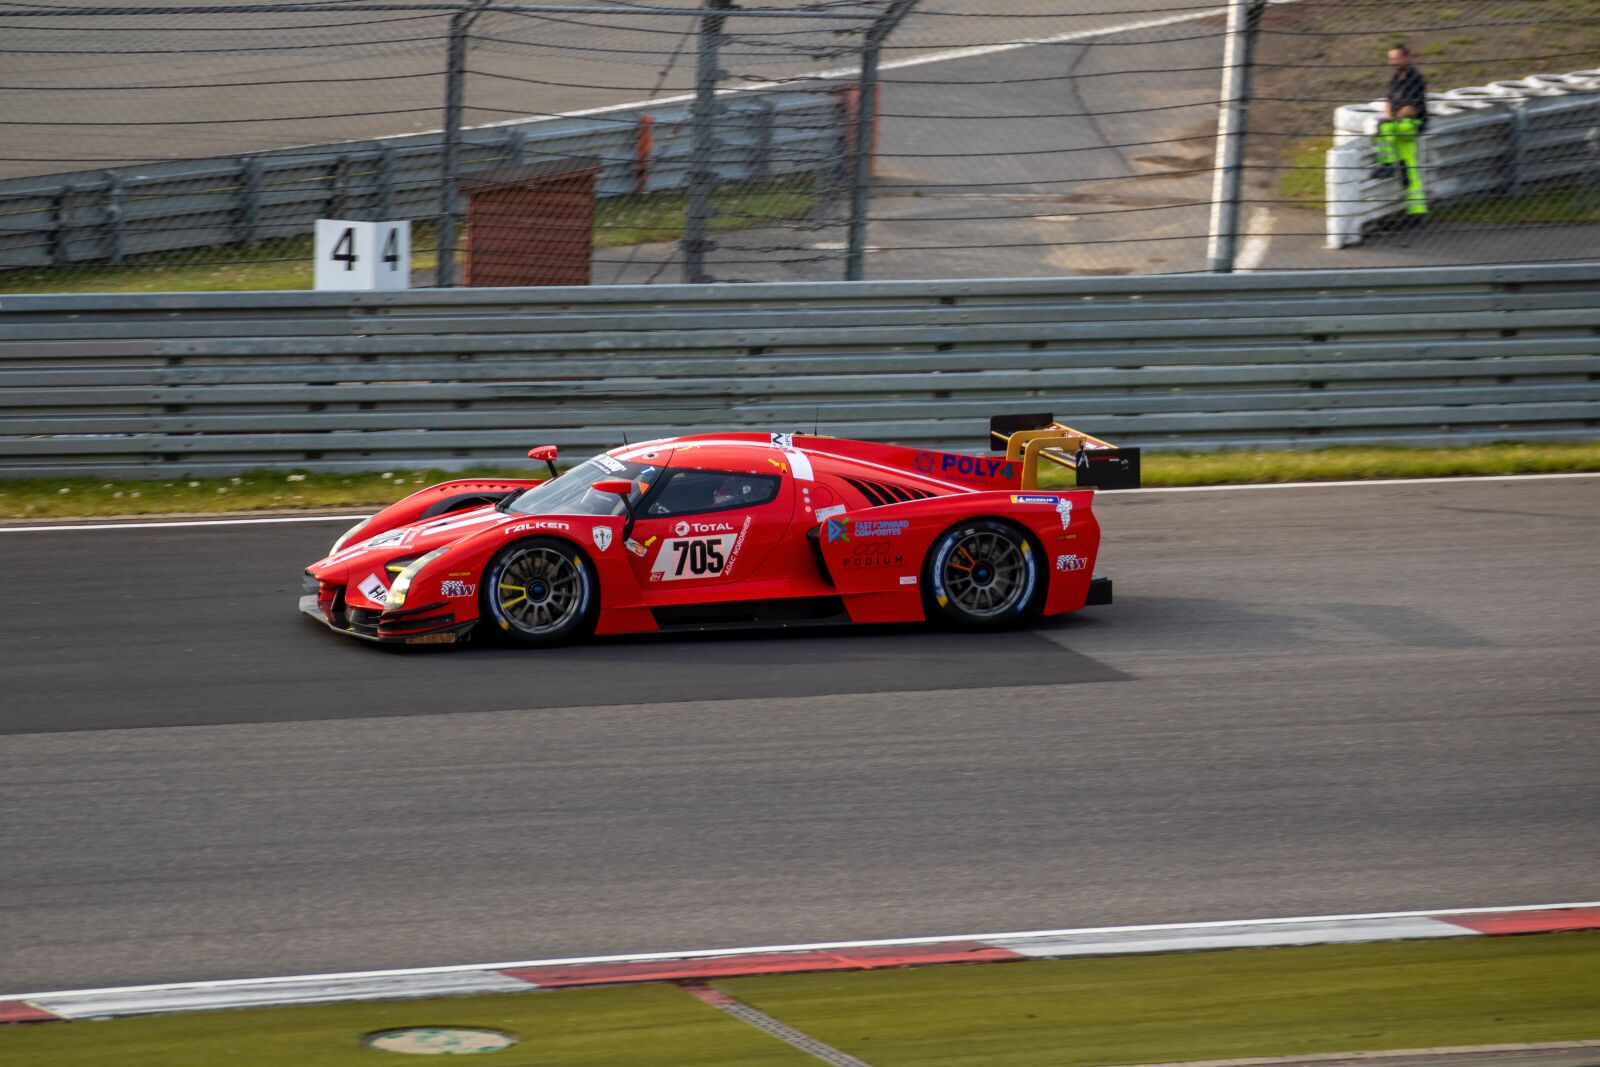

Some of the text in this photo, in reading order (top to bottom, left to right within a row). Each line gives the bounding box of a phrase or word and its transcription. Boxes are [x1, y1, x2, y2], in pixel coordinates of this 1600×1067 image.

[329, 227, 359, 272] 4
[381, 227, 401, 272] 4
[941, 453, 1014, 480] POLY4
[505, 521, 570, 535] FALKEN
[692, 522, 734, 533] TOTAL
[855, 521, 872, 530] FAST
[855, 527, 902, 537] COMPOSITES
[725, 515, 752, 576] ADAC NORDRHEIN
[673, 538, 724, 577] 705
[843, 555, 904, 567] PODIUM
[1062, 557, 1087, 572] KW
[447, 582, 475, 598] KW
